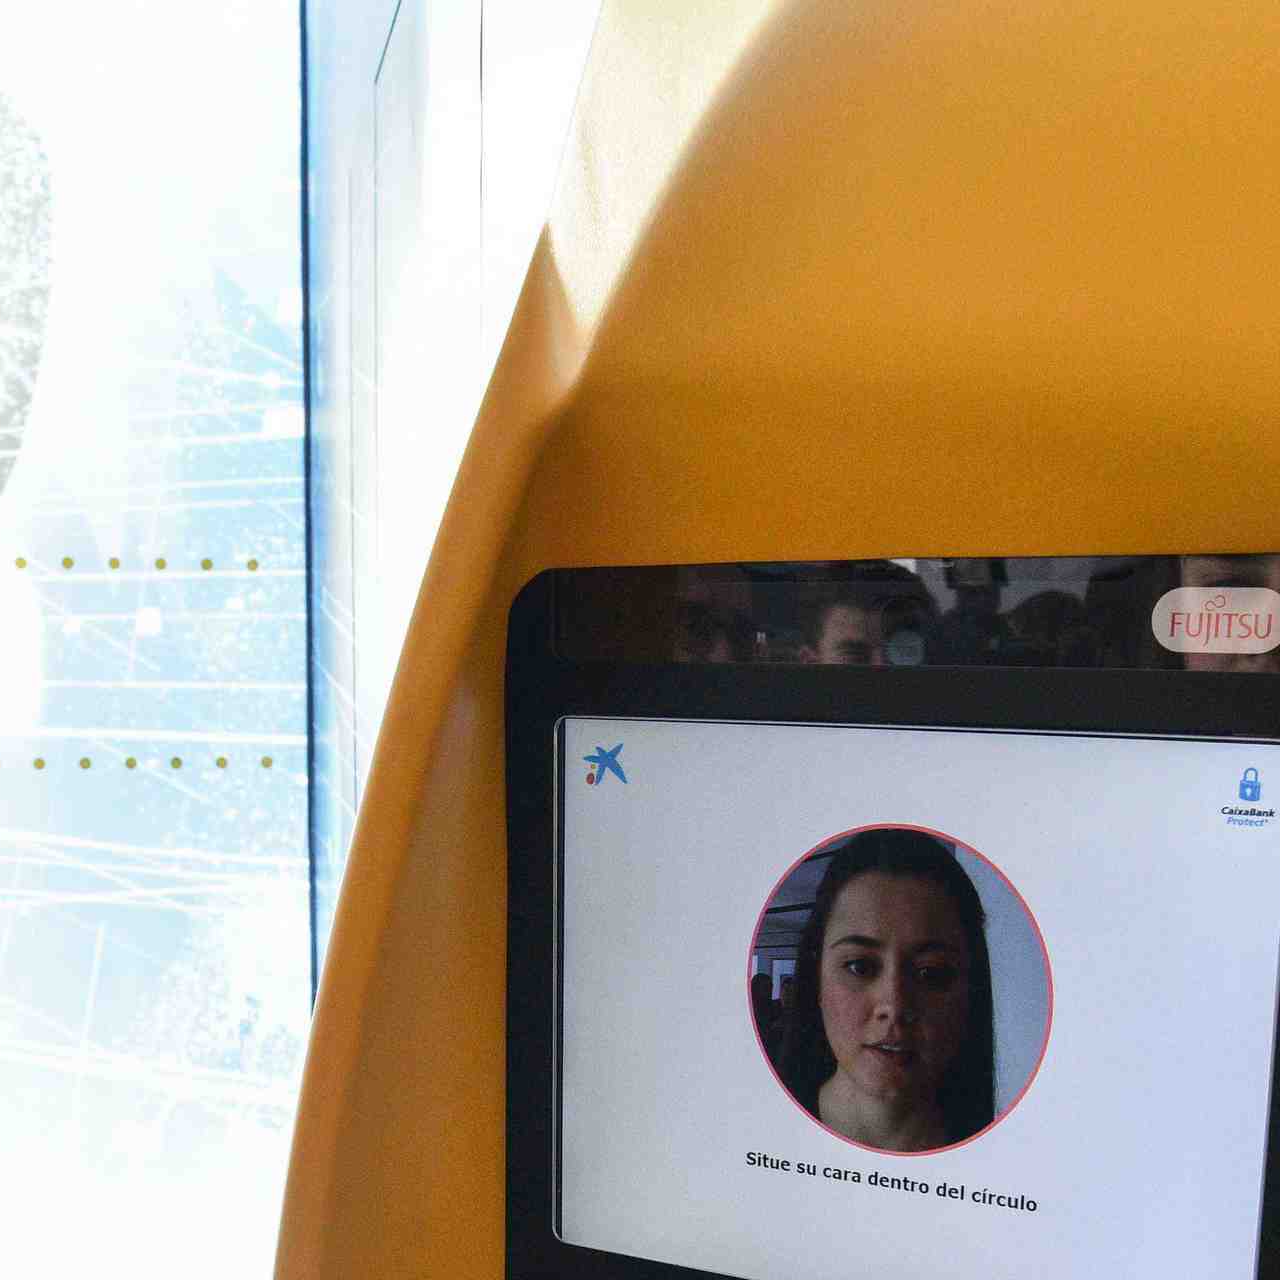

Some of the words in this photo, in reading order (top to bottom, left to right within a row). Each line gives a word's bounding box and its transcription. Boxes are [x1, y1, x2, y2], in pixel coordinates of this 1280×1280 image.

[1170, 611, 1273, 647] FUJITSU
[1221, 806, 1276, 817] CaixaBank
[745, 1151, 792, 1172] Situe
[796, 1163, 817, 1176] su
[822, 1165, 862, 1184] cara
[867, 1171, 930, 1194] dentro
[935, 1182, 966, 1201] del
[971, 1187, 1039, 1212] círculo
